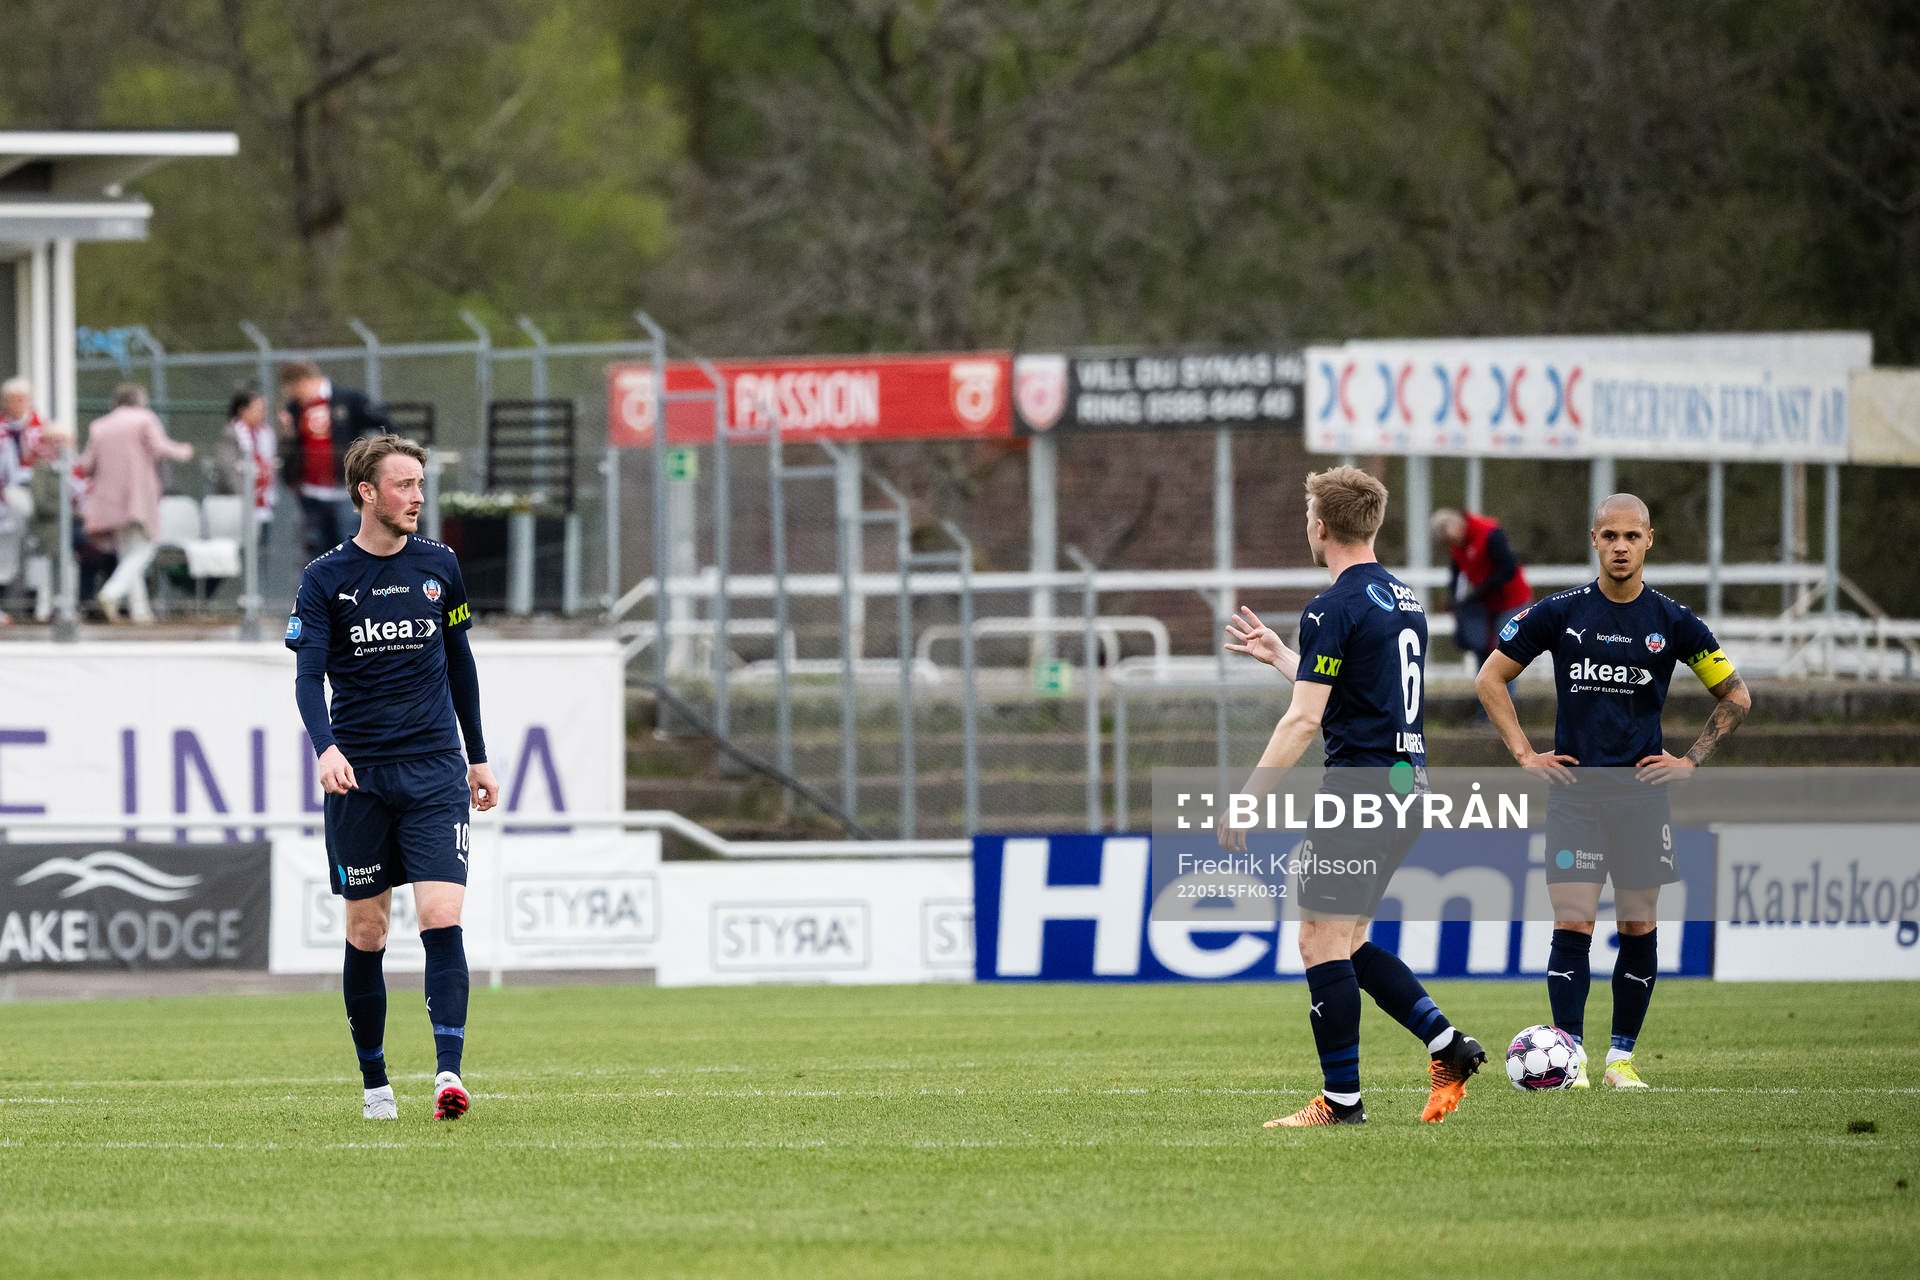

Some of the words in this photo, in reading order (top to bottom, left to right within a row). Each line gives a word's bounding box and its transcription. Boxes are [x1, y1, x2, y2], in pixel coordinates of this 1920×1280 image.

[734, 371, 880, 430] PASSION
[448, 602, 471, 627] XXL
[349, 618, 414, 643] akea
[1398, 628, 1420, 725] 6
[1569, 657, 1628, 683] akea
[453, 822, 470, 852] 10
[1661, 823, 1672, 851] 9
[1576, 850, 1604, 862] Resurs
[1576, 860, 1597, 870] Bank
[347, 863, 381, 877] Resurs
[348, 875, 375, 887] Bank
